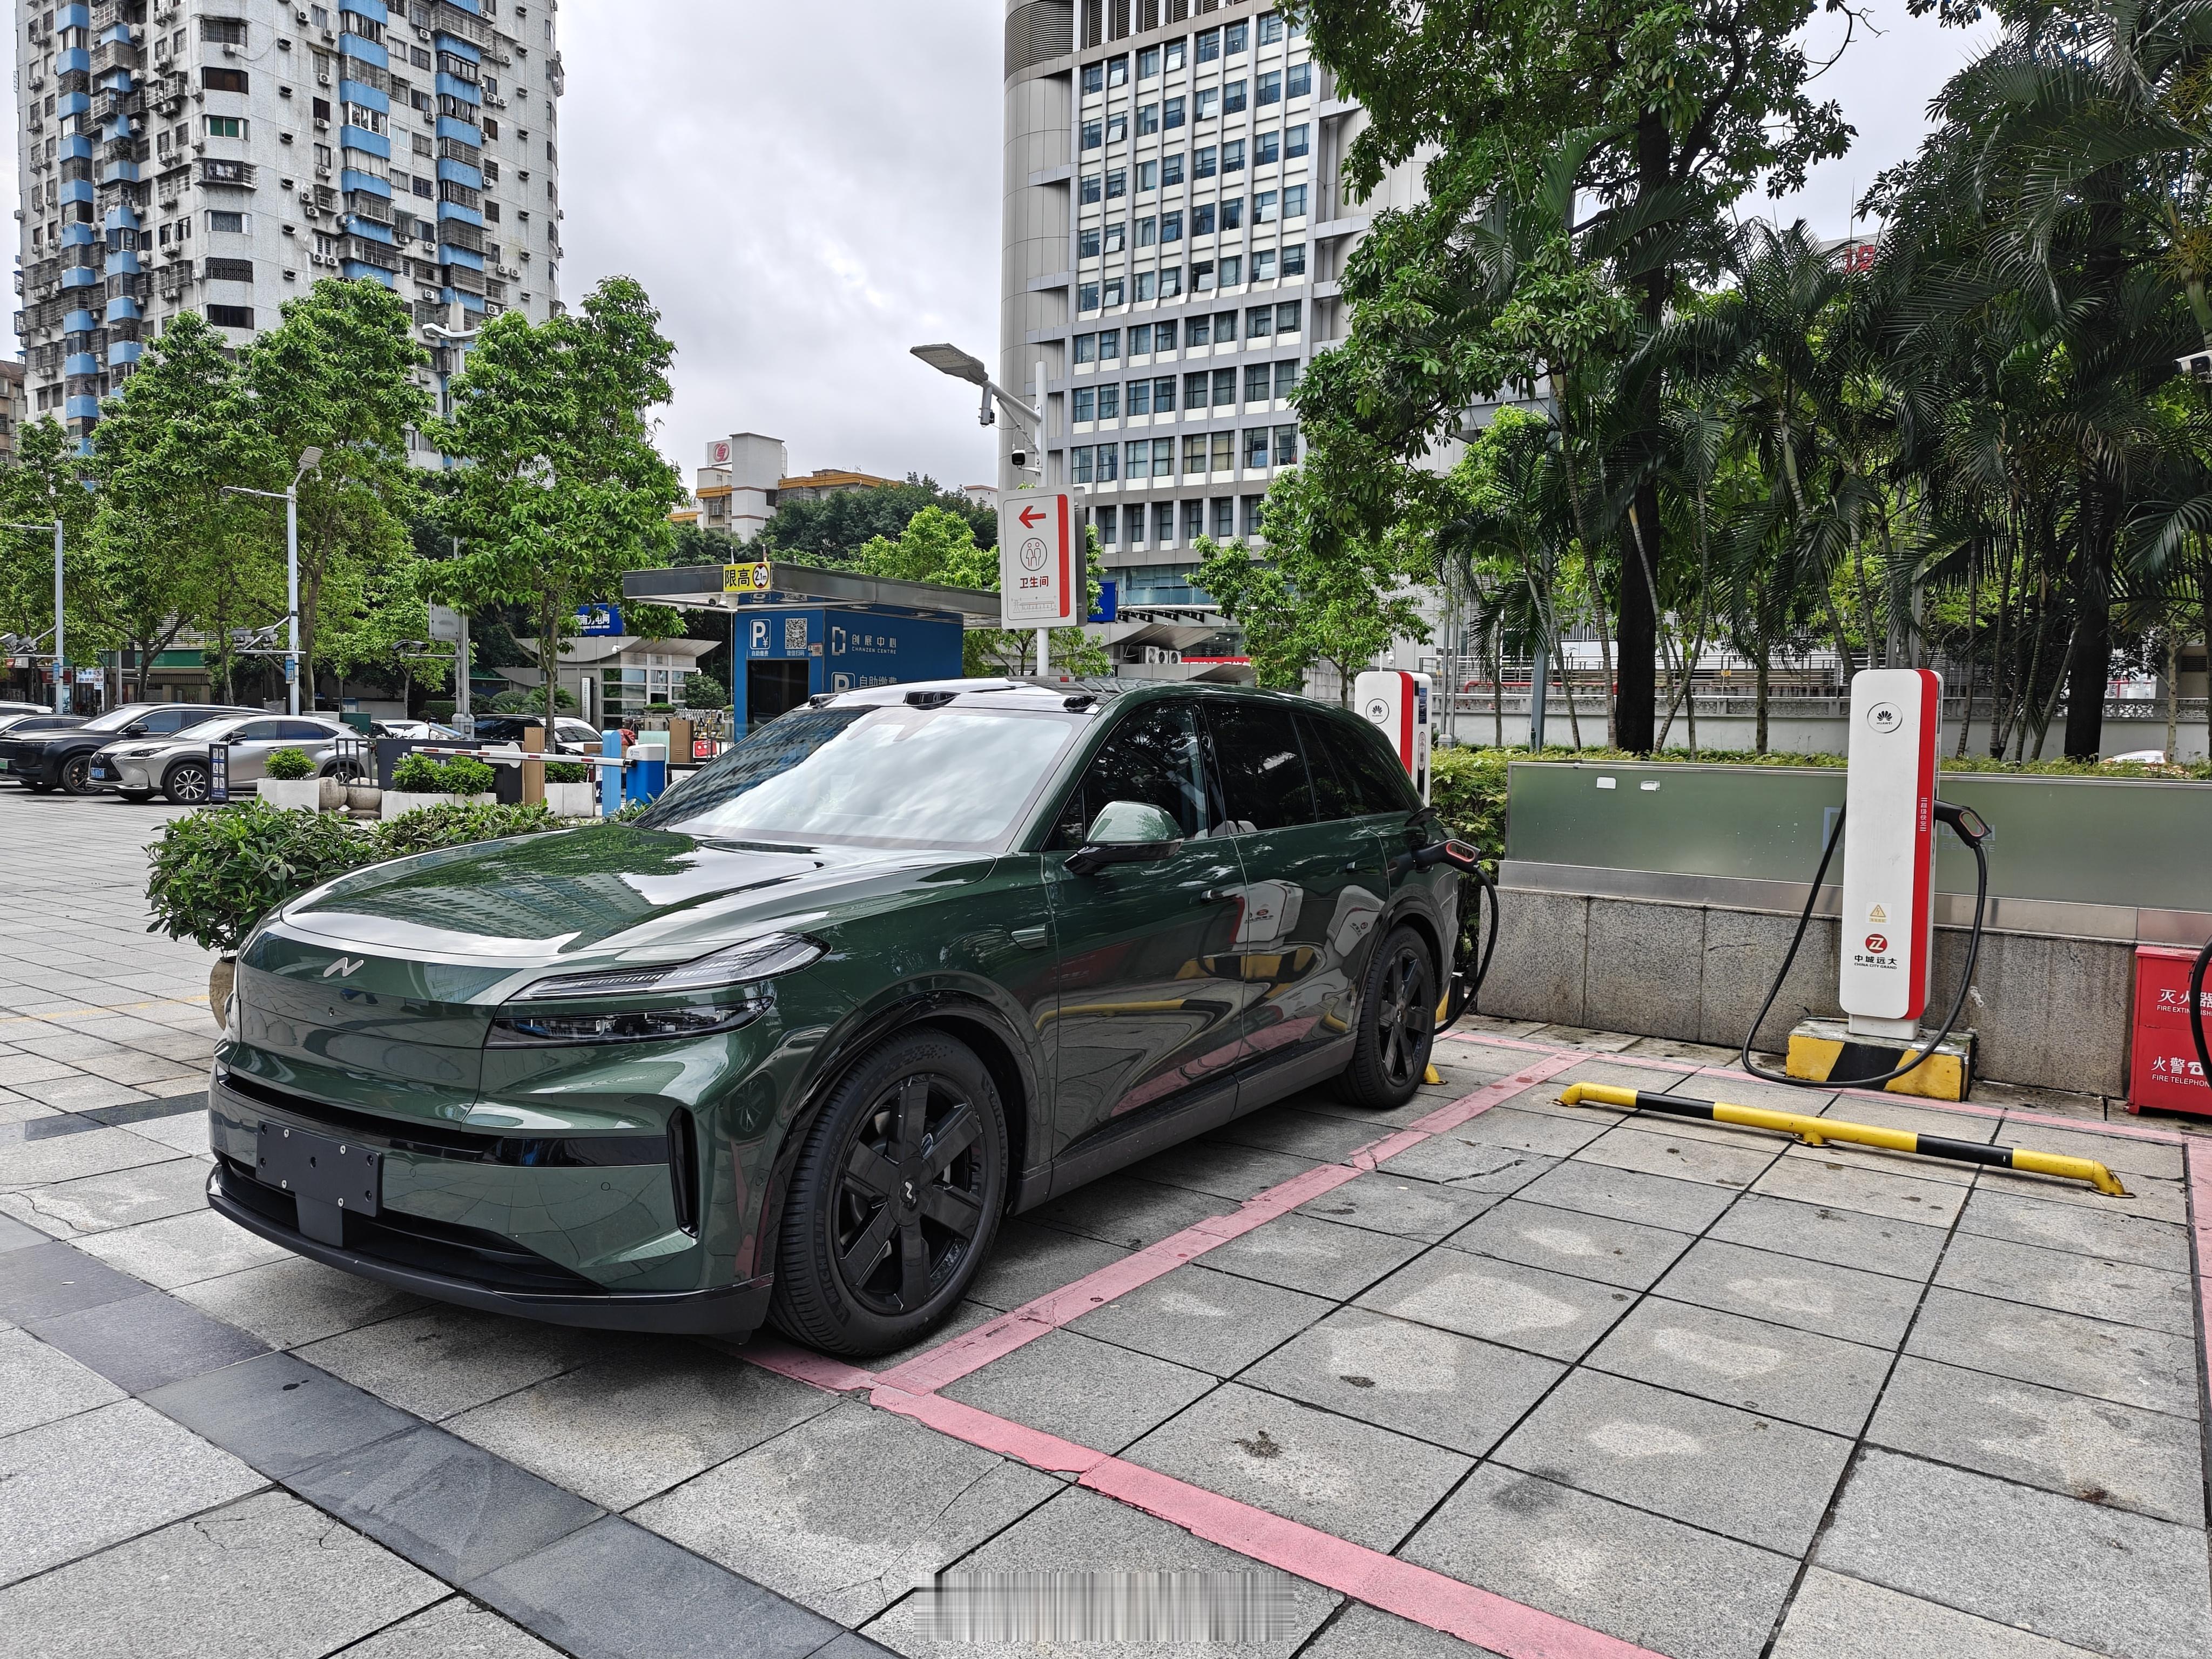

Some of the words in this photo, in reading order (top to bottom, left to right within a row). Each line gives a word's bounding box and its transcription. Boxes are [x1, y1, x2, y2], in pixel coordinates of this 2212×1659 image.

[725, 568, 750, 588] 限高
[1020, 576, 1049, 589] 卫生间
[852, 635, 896, 648] 创展中心
[1854, 955, 1897, 966] 中城远大
[2157, 989, 2212, 1008] 灭火器
[2173, 1007, 2212, 1016] EXTINISH
[2151, 1056, 2186, 1075] 火警
[2152, 1074, 2169, 1082] FIRE
[2170, 1076, 2210, 1088] TELEPHON
[815, 1209, 840, 1304] MICHELIN
